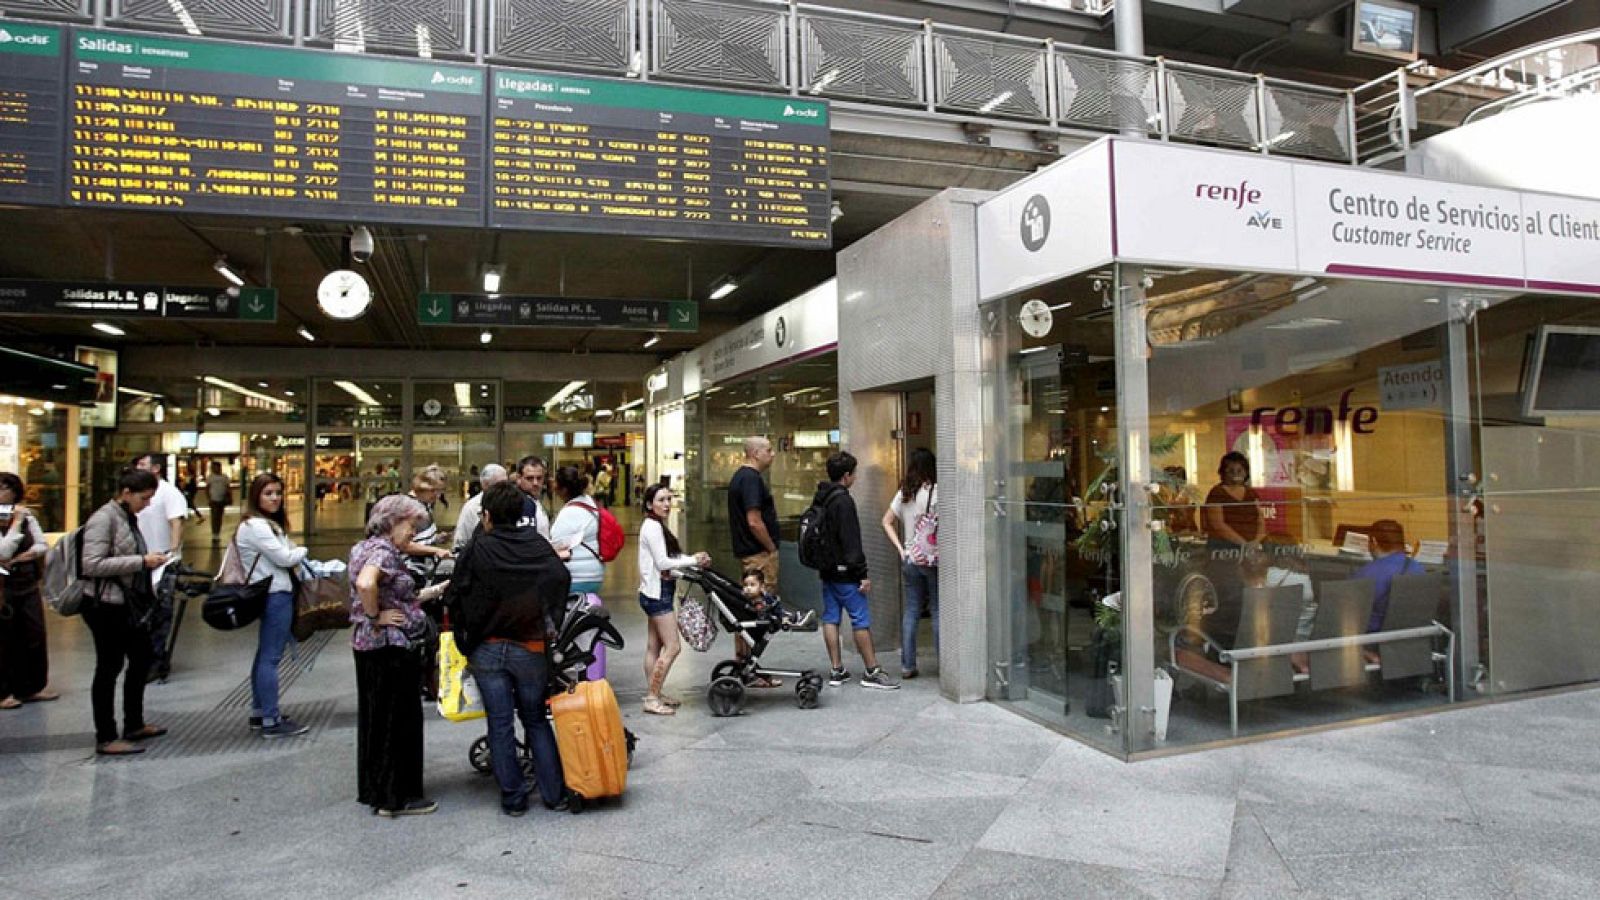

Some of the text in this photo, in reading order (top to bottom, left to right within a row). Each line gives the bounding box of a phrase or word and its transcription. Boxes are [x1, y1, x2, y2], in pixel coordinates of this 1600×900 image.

[79, 37, 133, 54] Salidas
[499, 78, 554, 93] Llegadas
[1196, 180, 1262, 210] renfe
[1246, 210, 1283, 231] AVE
[1329, 187, 1600, 241] Centro de Servicios al Client
[1332, 221, 1472, 254] Customer Service
[63, 289, 105, 300] Salidas
[166, 293, 209, 305] Llegadas
[474, 301, 512, 313] Llegadas
[536, 302, 569, 313] Salidas
[621, 305, 648, 315] Aseos
[1251, 387, 1378, 436] renfe
[1211, 541, 1258, 564] renfe
